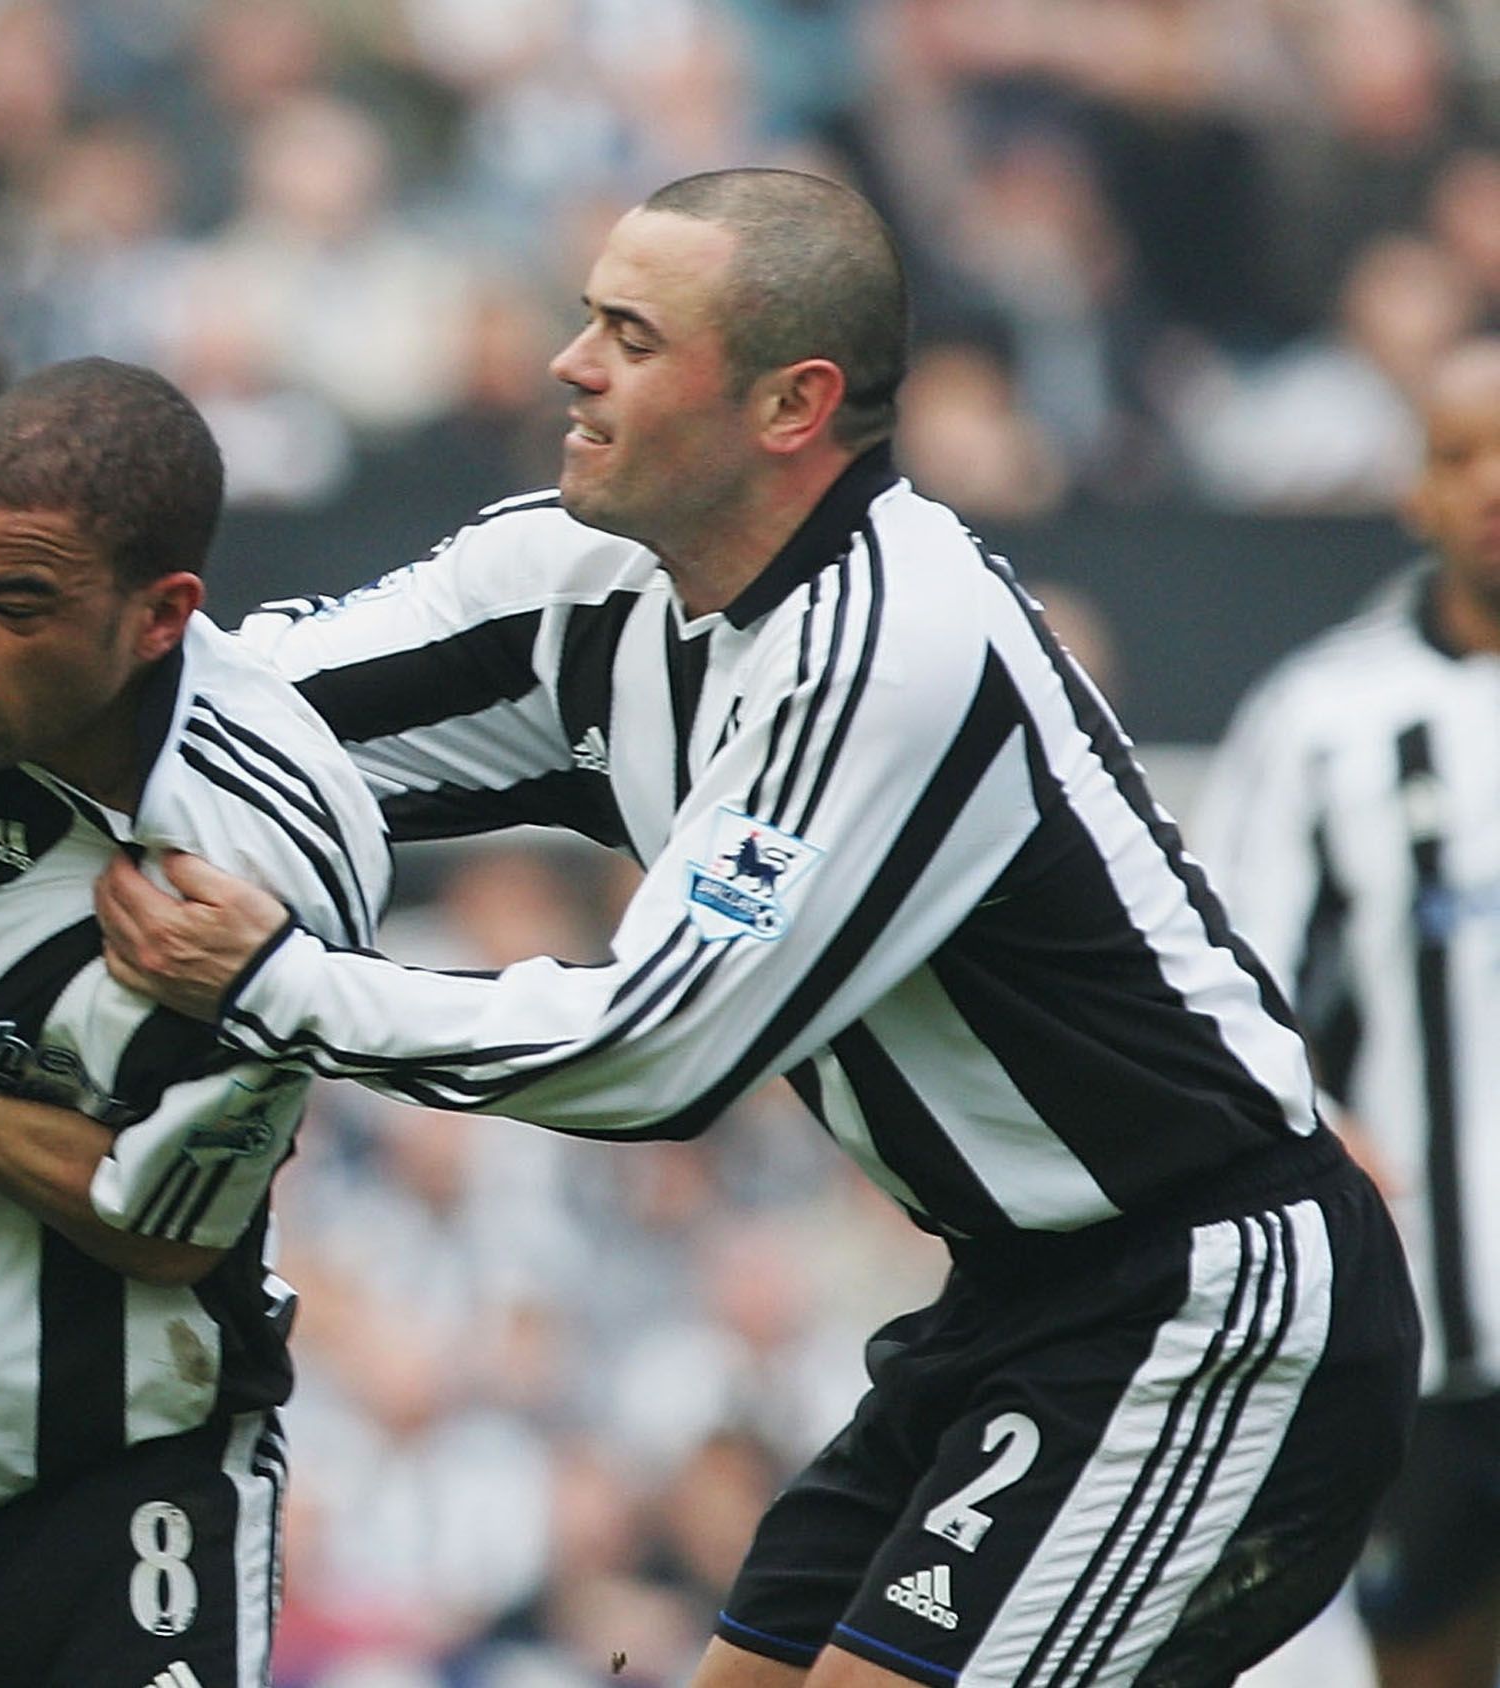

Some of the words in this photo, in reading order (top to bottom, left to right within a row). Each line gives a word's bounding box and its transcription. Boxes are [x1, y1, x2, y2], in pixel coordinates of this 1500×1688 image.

[923, 1411, 1041, 1553] 2
[129, 1501, 198, 1637] 8
[884, 1584, 959, 1630] adidas
